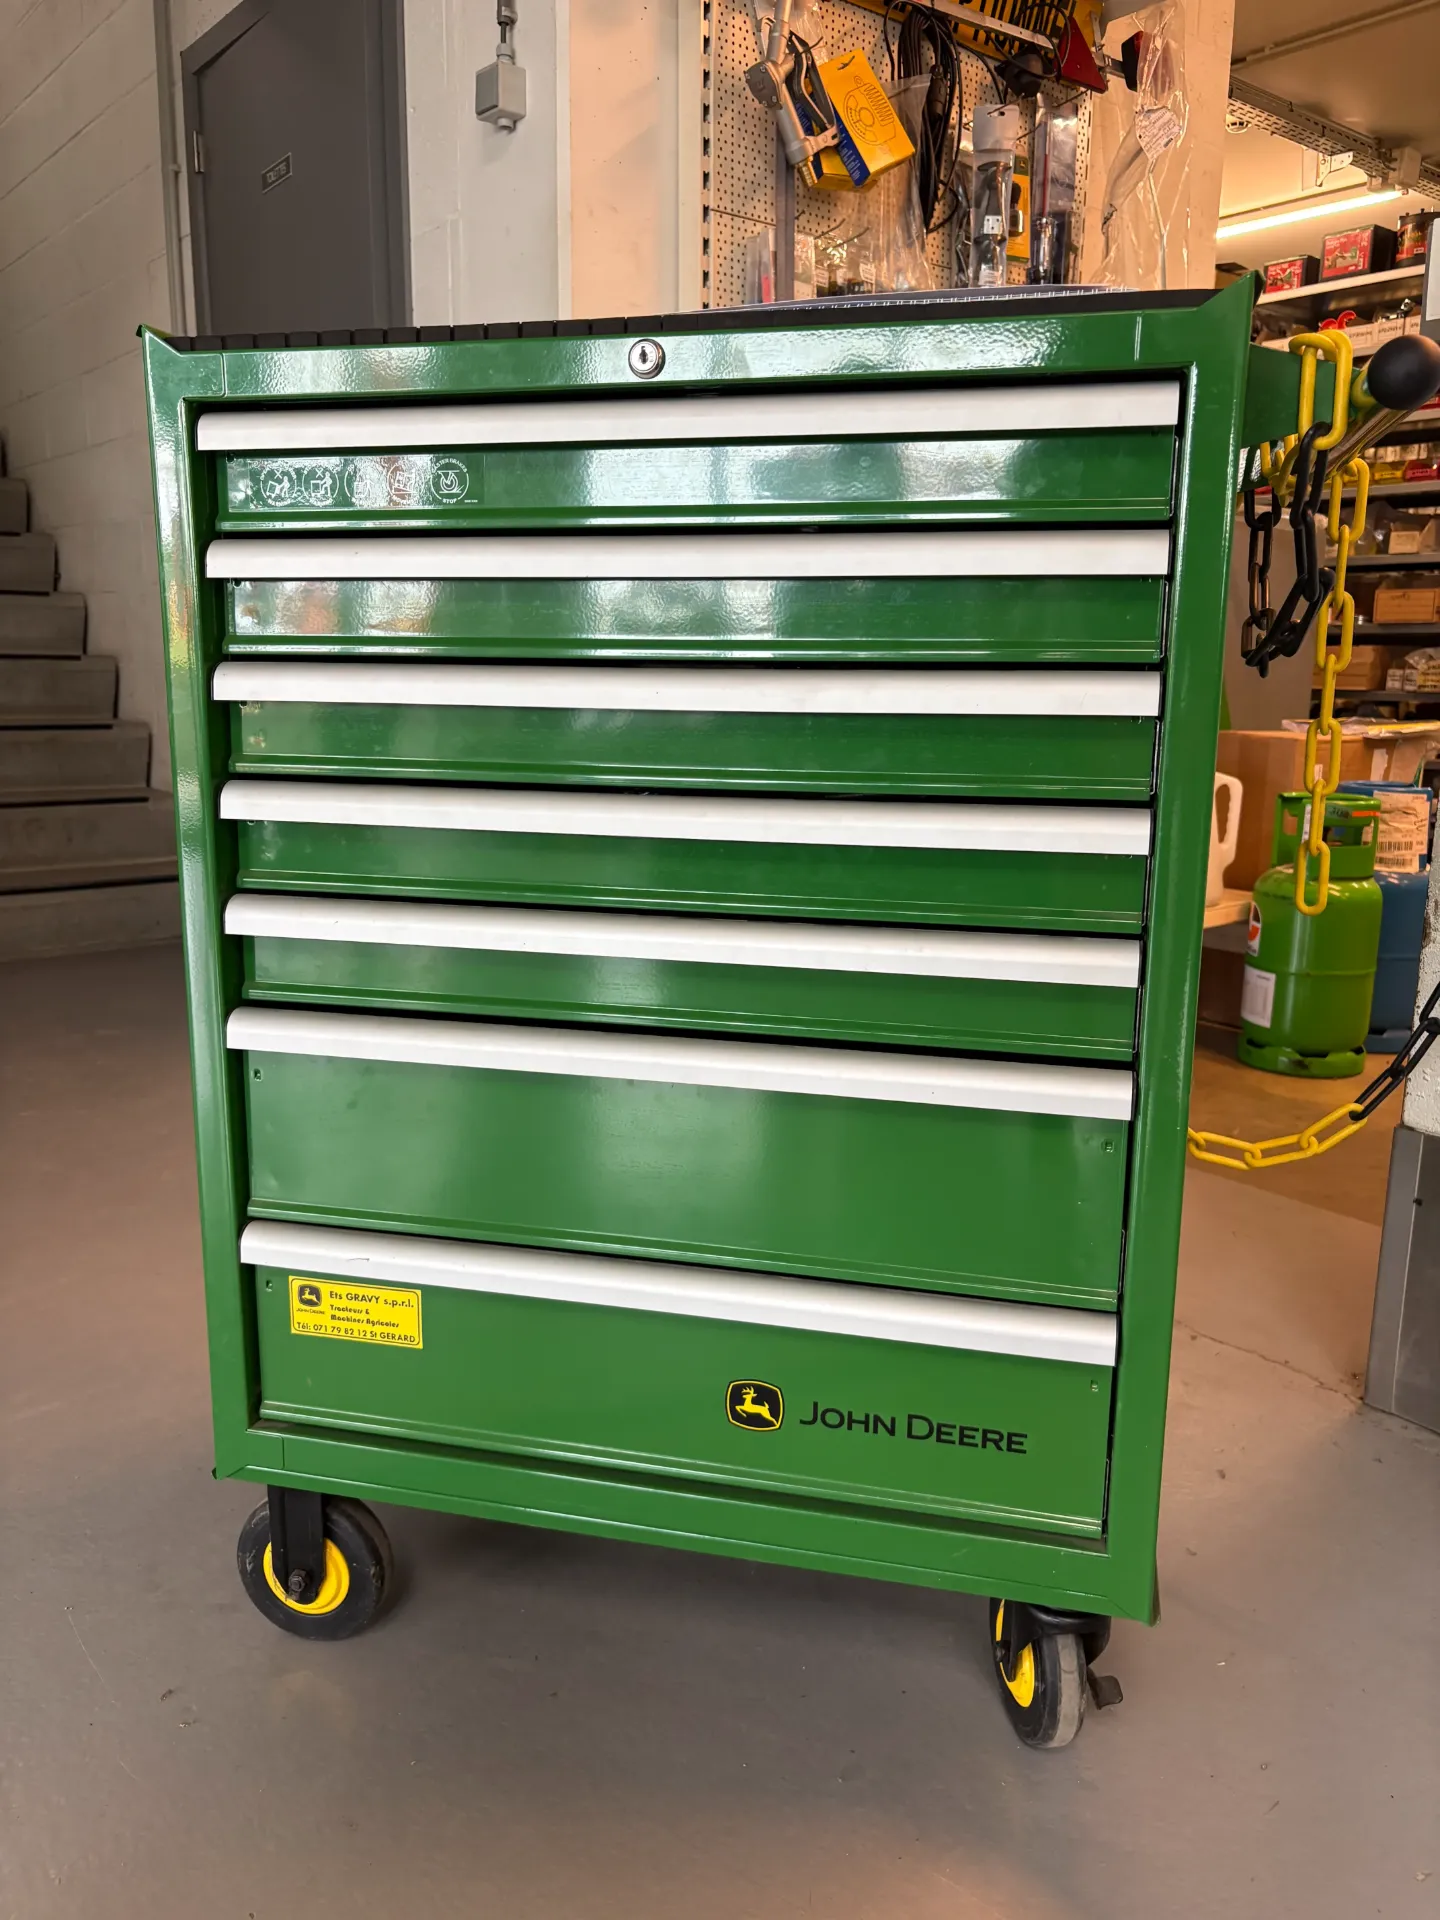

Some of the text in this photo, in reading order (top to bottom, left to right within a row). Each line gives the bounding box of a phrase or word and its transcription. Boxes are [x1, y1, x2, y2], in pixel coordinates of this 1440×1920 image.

[329, 1290, 414, 1308] Ets GRAVY s.p.r.l.
[330, 1304, 363, 1314] Tracteurs
[330, 1314, 399, 1328] Machines Agricoles
[313, 1323, 328, 1332] 071
[331, 1326, 342, 1334] 79
[344, 1328, 354, 1336] 82
[358, 1329, 367, 1337] 12
[370, 1330, 377, 1338] St
[379, 1332, 416, 1343] GERARD
[799, 1401, 1028, 1455] JOHN DEERE
